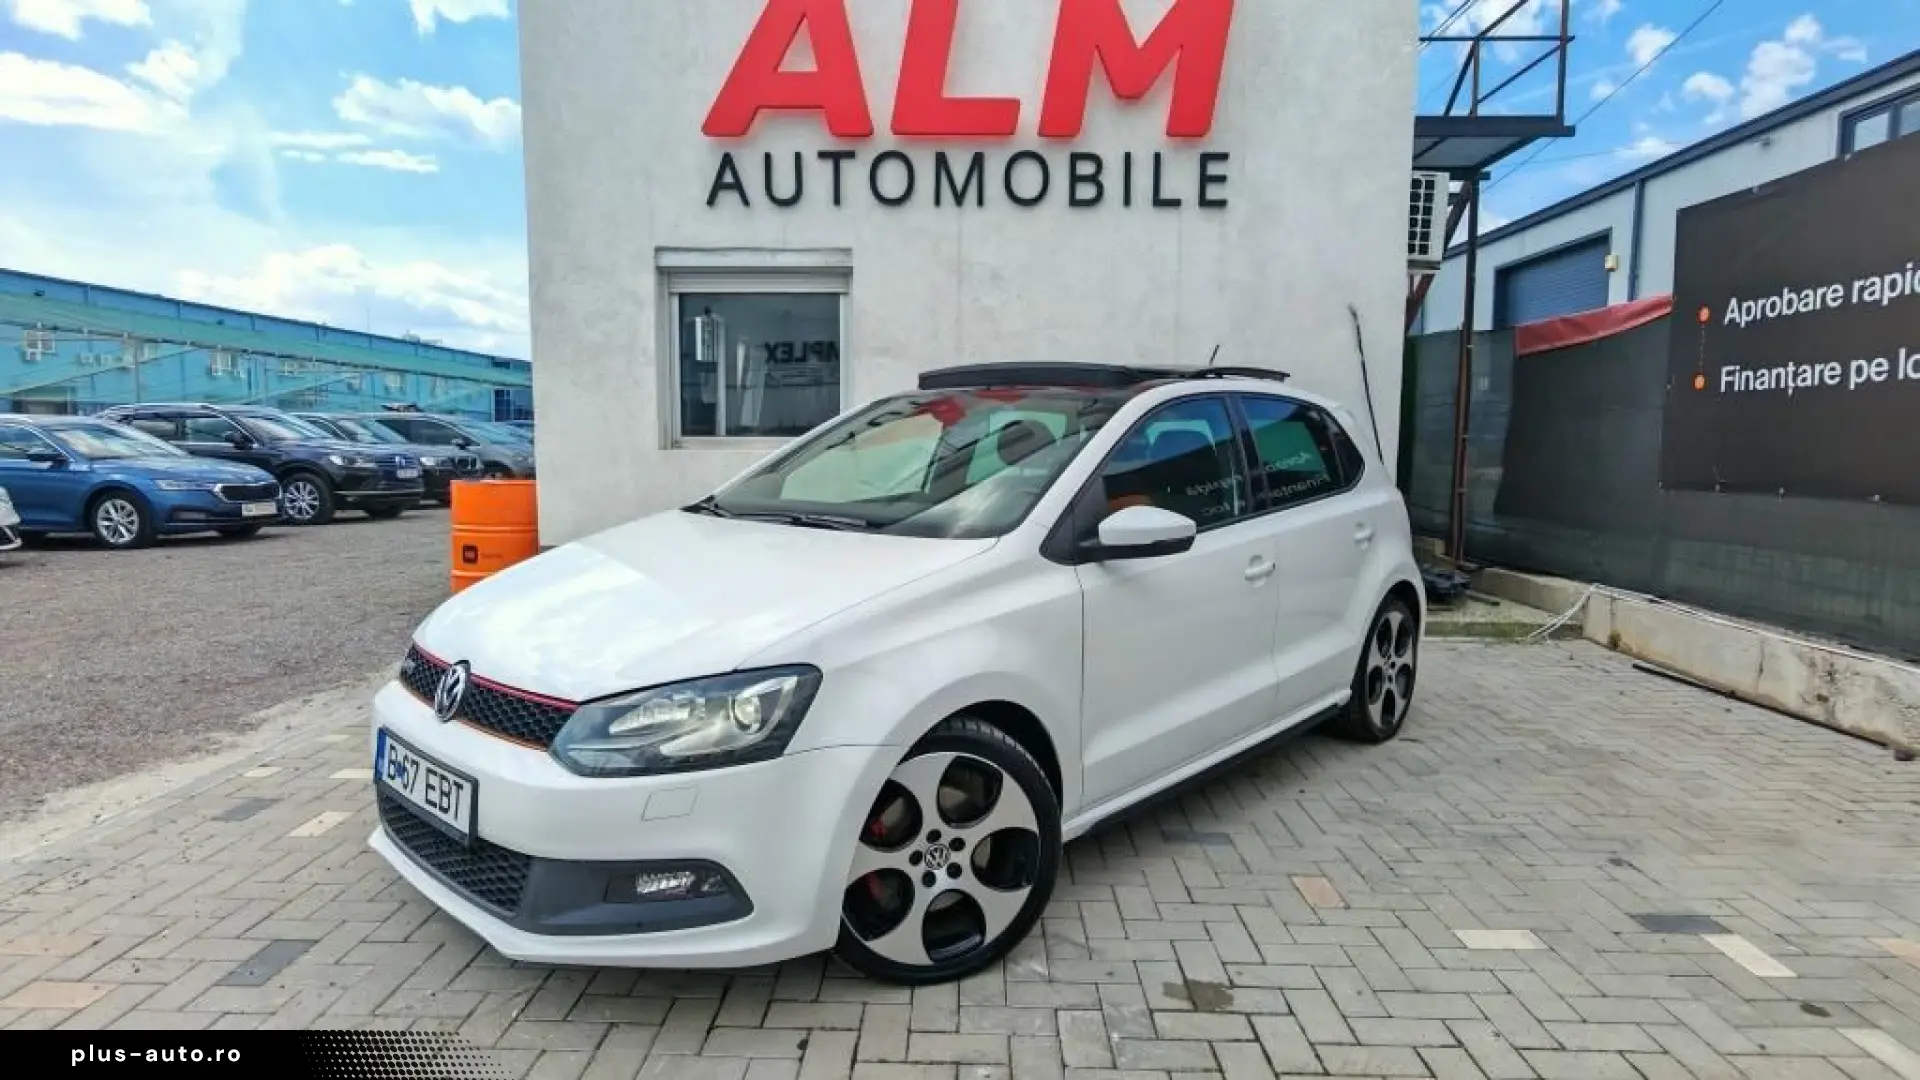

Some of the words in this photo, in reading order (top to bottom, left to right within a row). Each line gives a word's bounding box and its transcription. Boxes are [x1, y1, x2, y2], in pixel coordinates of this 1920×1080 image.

[701, 0, 1234, 137] ALM
[706, 150, 1231, 208] AUTOMOBILE
[1724, 283, 1844, 328] Aprobare
[1720, 361, 1842, 396] Finanțare
[1849, 357, 1889, 390] pe
[425, 766, 464, 821] EBT
